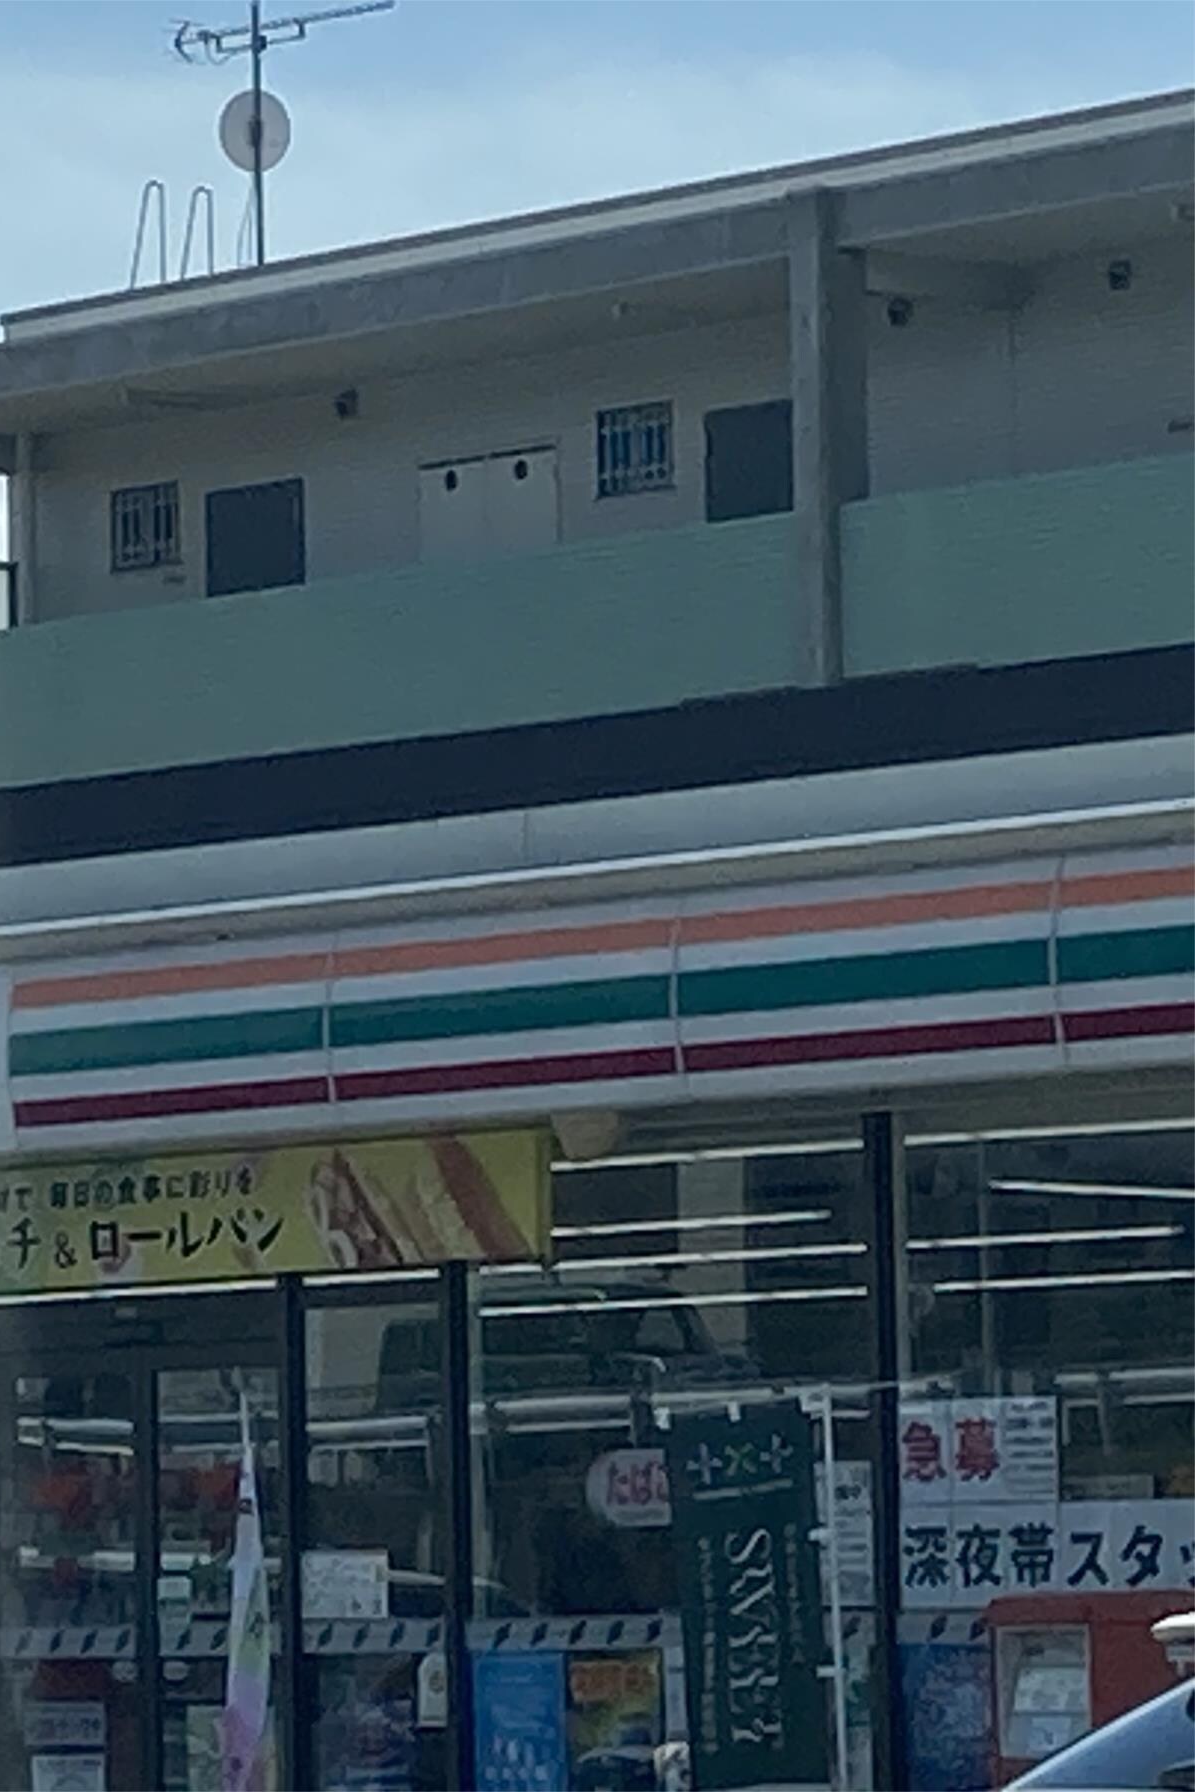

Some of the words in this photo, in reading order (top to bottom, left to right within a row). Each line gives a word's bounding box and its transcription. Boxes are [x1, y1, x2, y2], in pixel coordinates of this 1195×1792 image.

[50, 1165, 252, 1209] 毎日の食事に彩りを
[54, 1231, 78, 1269] &
[90, 1206, 284, 1260] ロールパン
[903, 1418, 1000, 1482] 急募
